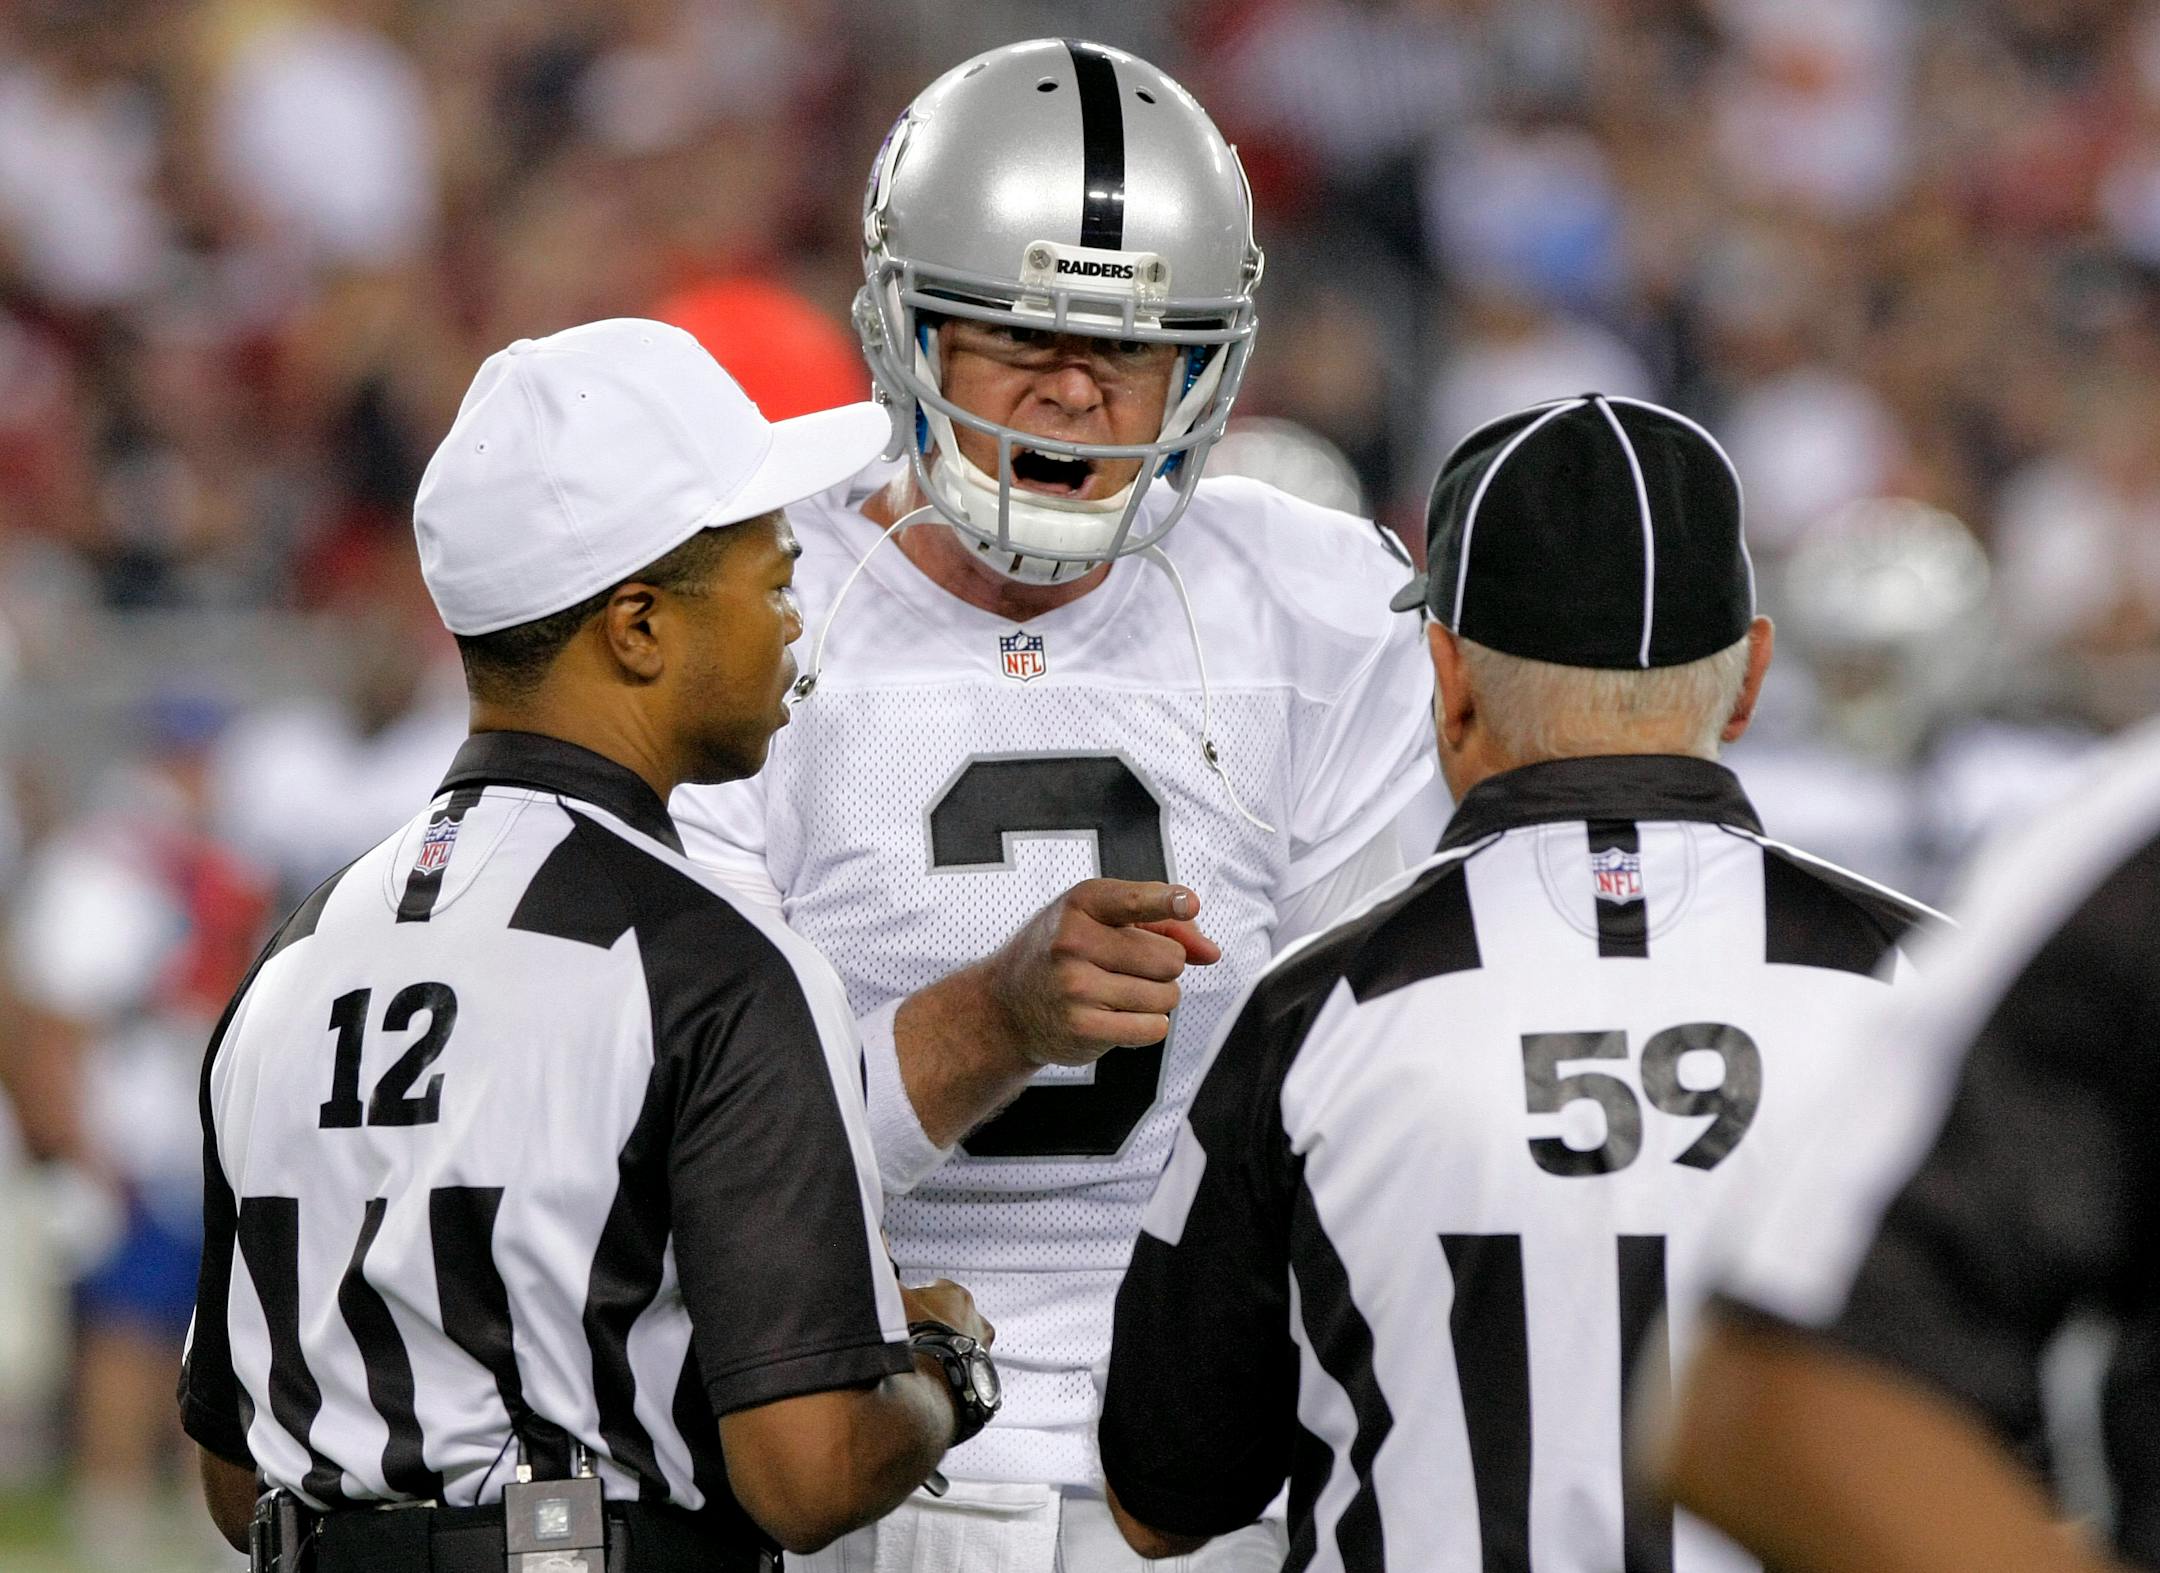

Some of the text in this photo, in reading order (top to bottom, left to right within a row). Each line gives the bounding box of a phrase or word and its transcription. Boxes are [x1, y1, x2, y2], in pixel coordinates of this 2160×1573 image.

[1057, 259, 1134, 279] RAIDERS
[1005, 652, 1042, 676] NFL
[419, 843, 449, 868] NFL
[1599, 871, 1641, 896] NFL
[318, 981, 458, 1129] 12
[1520, 1021, 1763, 1178] 59
